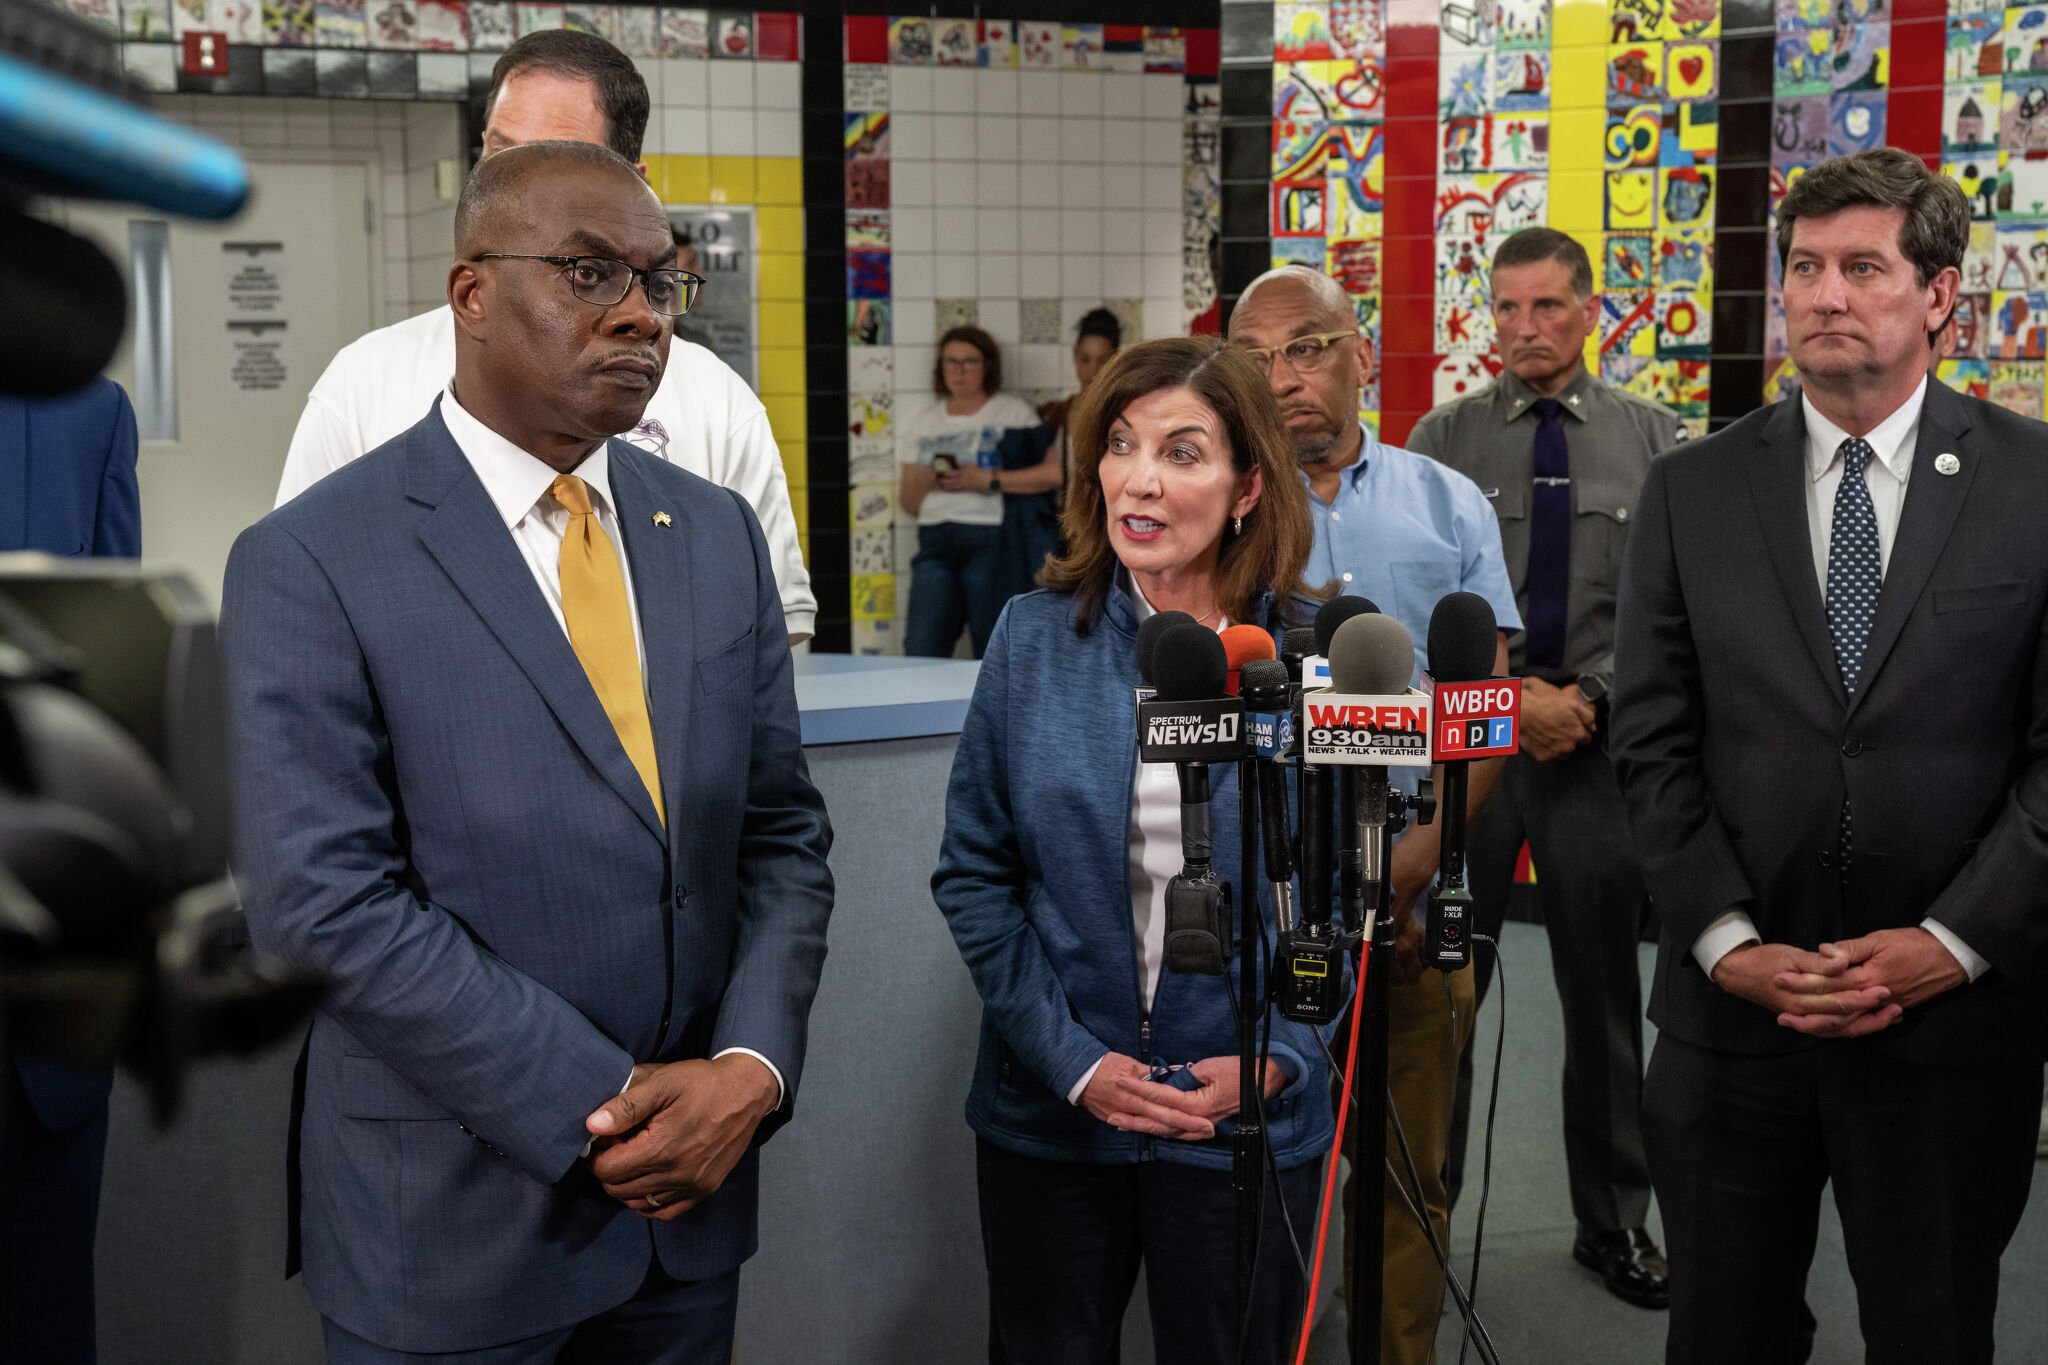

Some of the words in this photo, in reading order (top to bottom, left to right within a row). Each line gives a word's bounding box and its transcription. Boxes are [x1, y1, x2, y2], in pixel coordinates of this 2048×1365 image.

[703, 249, 744, 272] ILT
[1443, 688, 1514, 715] WBFO
[1149, 716, 1202, 726] SPECTRUM
[1245, 722, 1273, 736] HAM
[1308, 705, 1427, 734] WBEN
[1147, 724, 1217, 746] NEWS
[1246, 734, 1273, 748] EWS
[1312, 729, 1422, 747] 930am
[1447, 724, 1505, 747] npr
[1380, 748, 1427, 756] WEATHER
